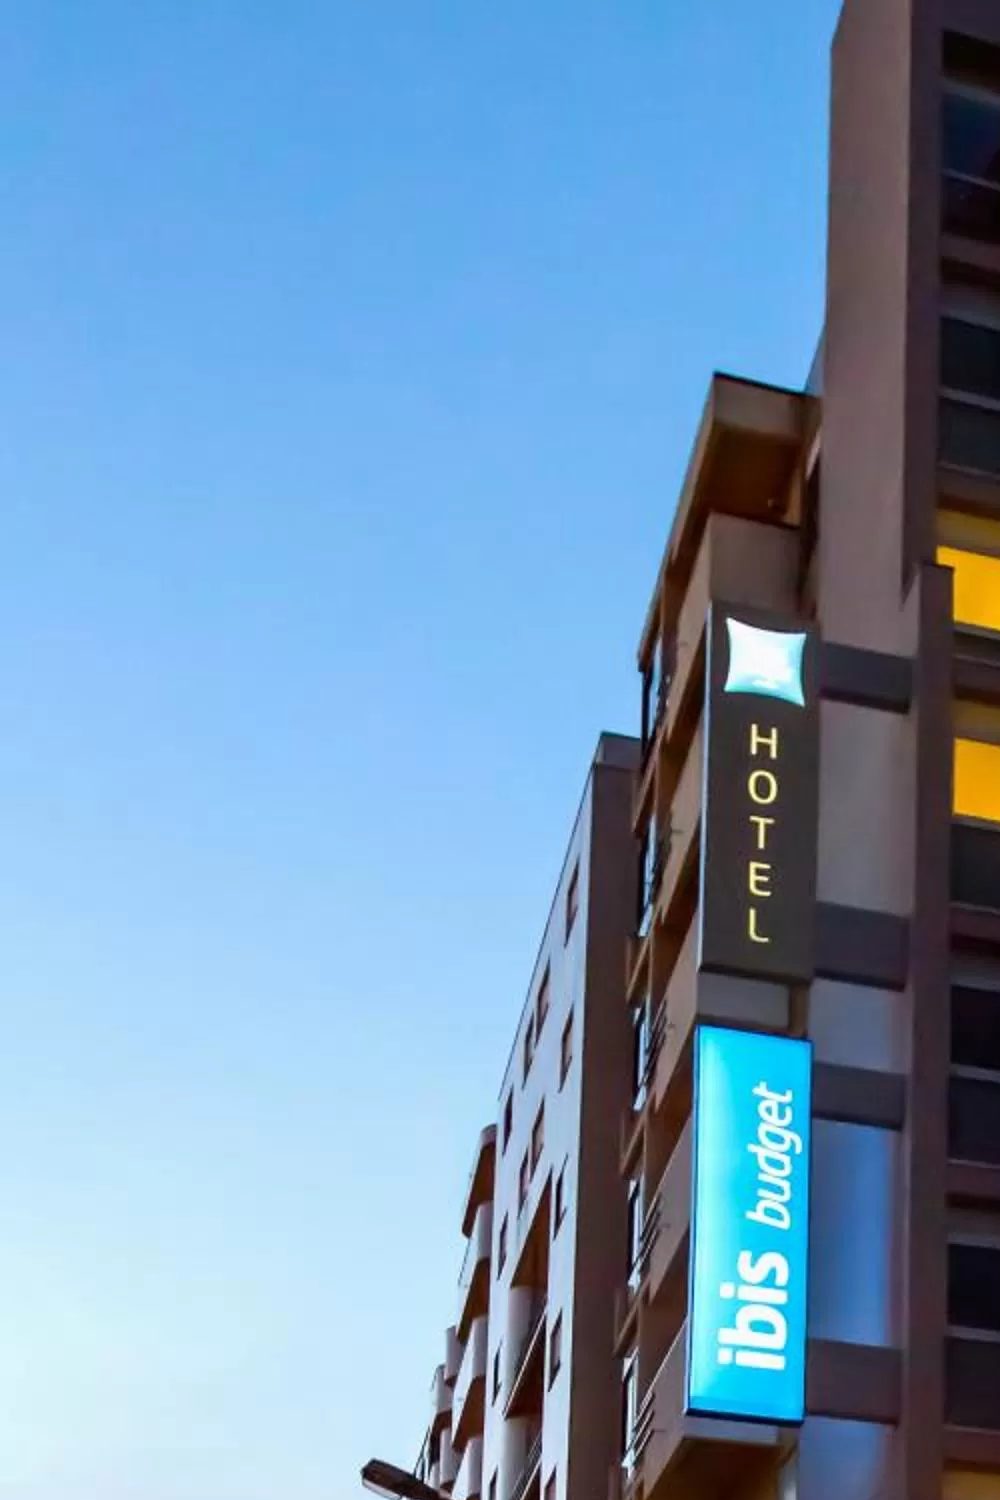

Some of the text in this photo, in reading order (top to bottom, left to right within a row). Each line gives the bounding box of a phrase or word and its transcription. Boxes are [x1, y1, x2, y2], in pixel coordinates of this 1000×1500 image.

[746, 722, 782, 944] HOTEL
[718, 1080, 803, 1372] ibis budget
